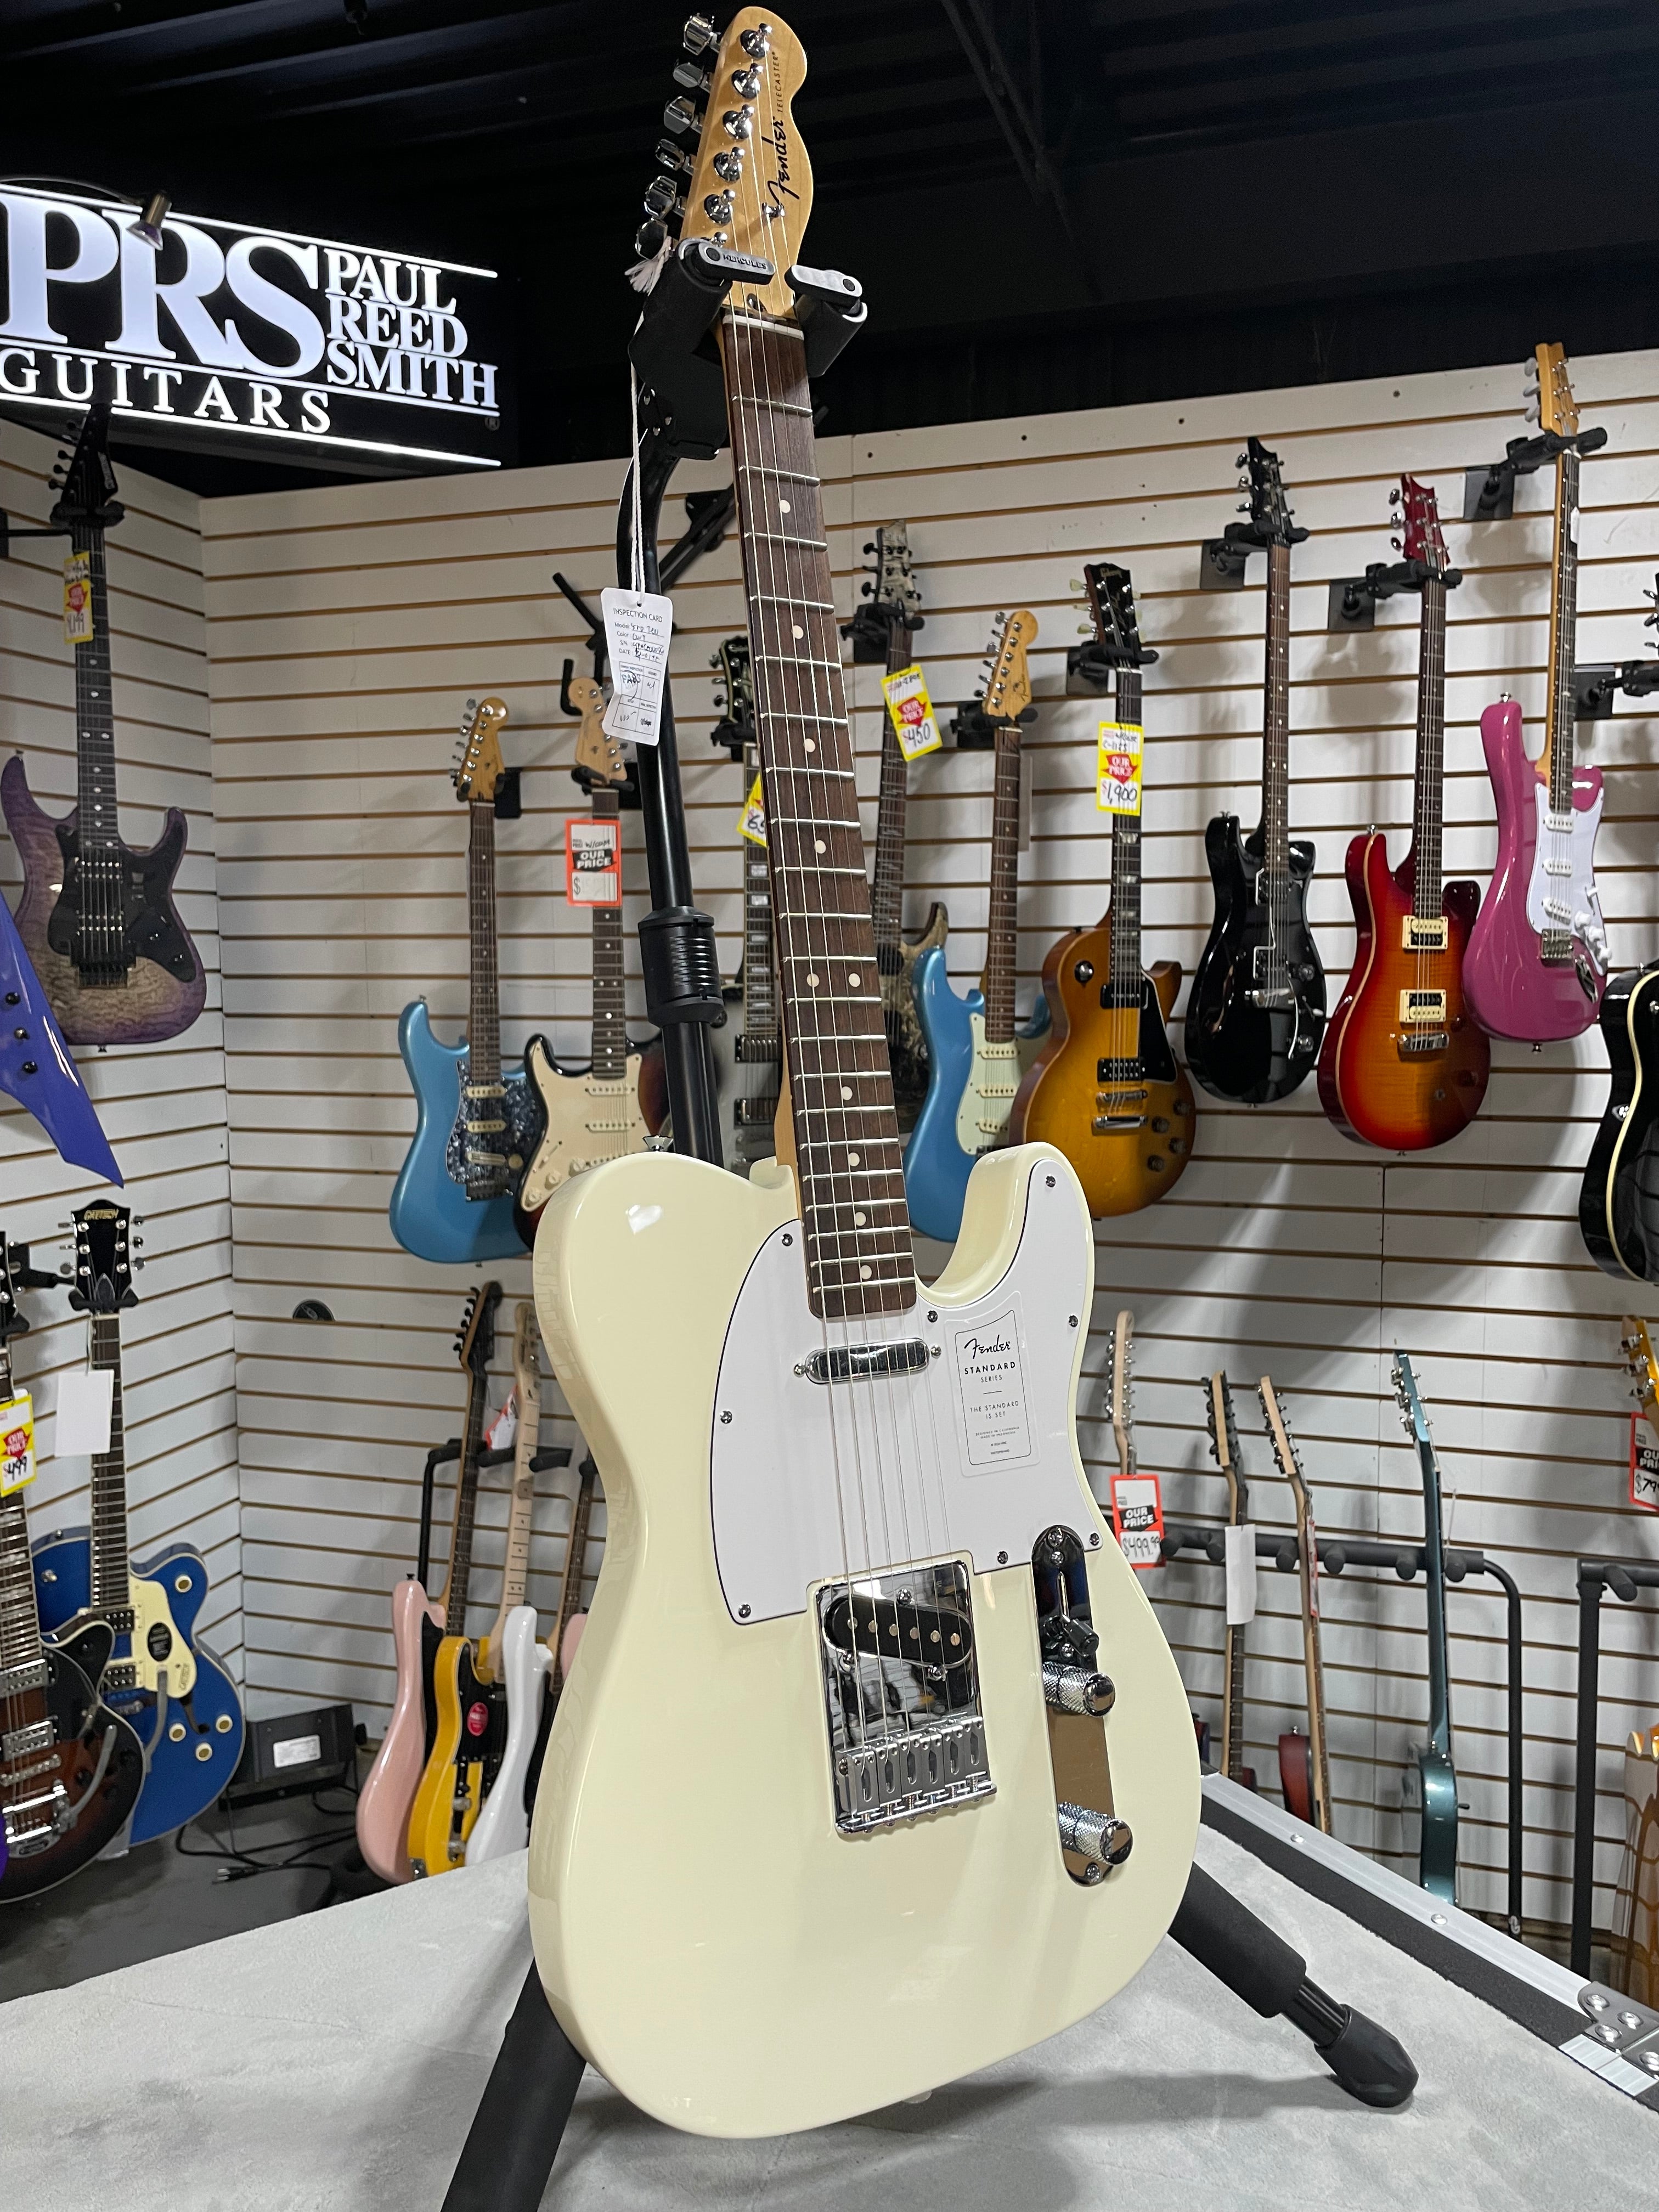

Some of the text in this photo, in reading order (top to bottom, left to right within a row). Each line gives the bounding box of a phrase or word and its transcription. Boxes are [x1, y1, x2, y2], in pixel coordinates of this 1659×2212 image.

[772, 55, 783, 112] TELECASTER
[761, 120, 800, 205] Fender
[723, 254, 767, 269] HERCULES
[0, 195, 325, 377] PRS
[325, 249, 456, 315] PAUL
[326, 294, 468, 358] REED
[327, 340, 499, 408] SMITH
[1, 347, 330, 433] GUITARS
[613, 607, 663, 623] INSPECTION CARD
[1111, 755, 1130, 767] OUR
[579, 850, 605, 860] OUR
[577, 857, 611, 870] PRICE
[964, 1334, 1011, 1359] Fender
[964, 1361, 1015, 1375] STANDARD
[980, 1374, 1002, 1383] SERIES
[985, 1401, 1019, 1411] STANDARD
[1639, 1457, 1659, 1469] PRI
[1125, 1507, 1148, 1519] OUR
[1123, 1514, 1154, 1529] PRICE
